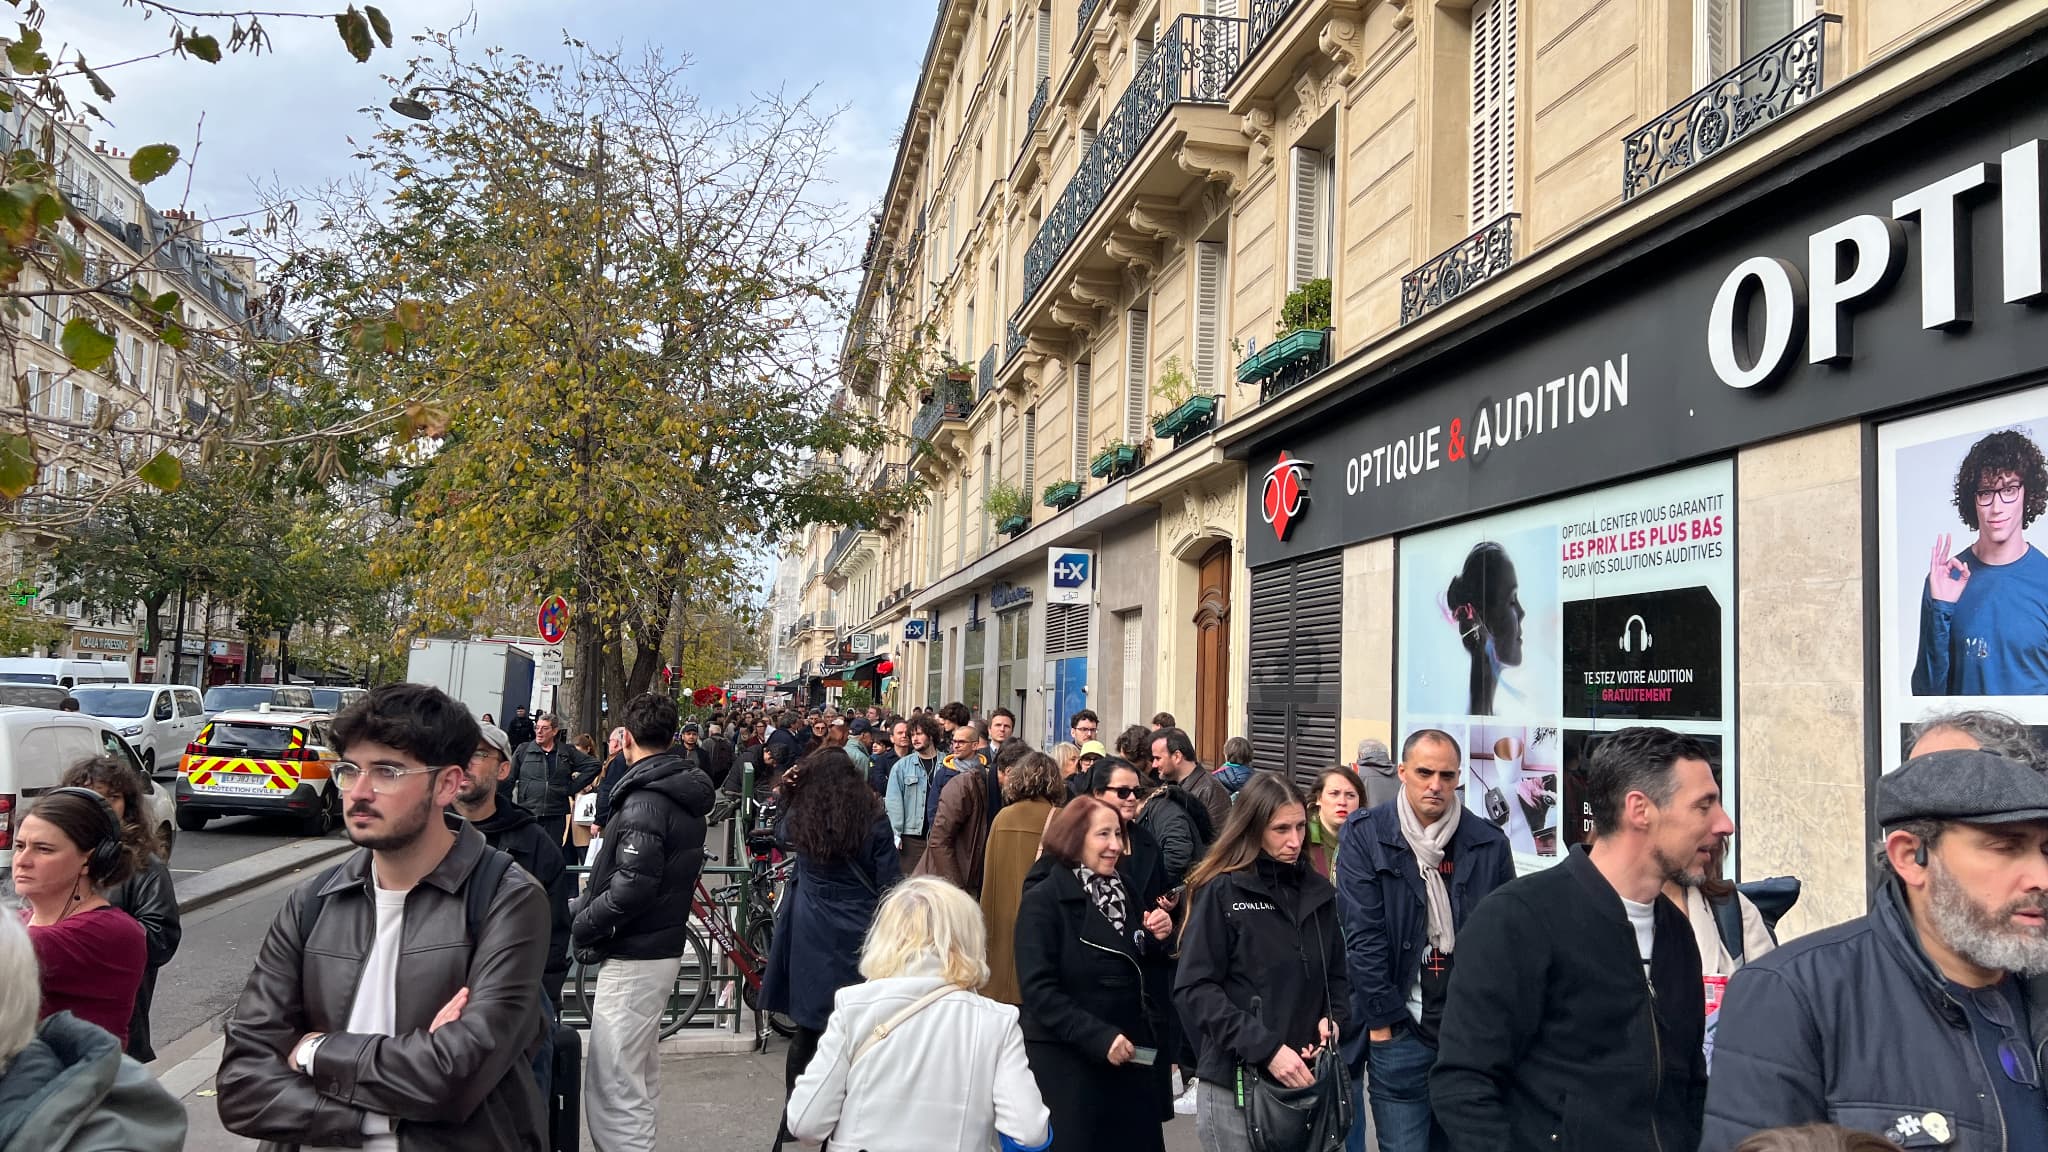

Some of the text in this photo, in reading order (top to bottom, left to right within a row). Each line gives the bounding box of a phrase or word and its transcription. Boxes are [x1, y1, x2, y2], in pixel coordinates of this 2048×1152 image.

[1346, 353, 1629, 496] OPTIQUE & AUDITION
[1562, 493, 1724, 540] OPTICAL CENTER VOUS GARANTIT
[1562, 515, 1723, 561] LES PRIX LES PLUS BAS
[1562, 541, 1723, 579] POUR VOS SOLUTIONS AUDITIVES
[1584, 669, 1693, 685] TESTEZ VOTRE AUDITION
[1602, 687, 1673, 702] GRATUITEMENT
[207, 784, 250, 793] PROTECTION
[702, 915, 734, 952] METEOR
